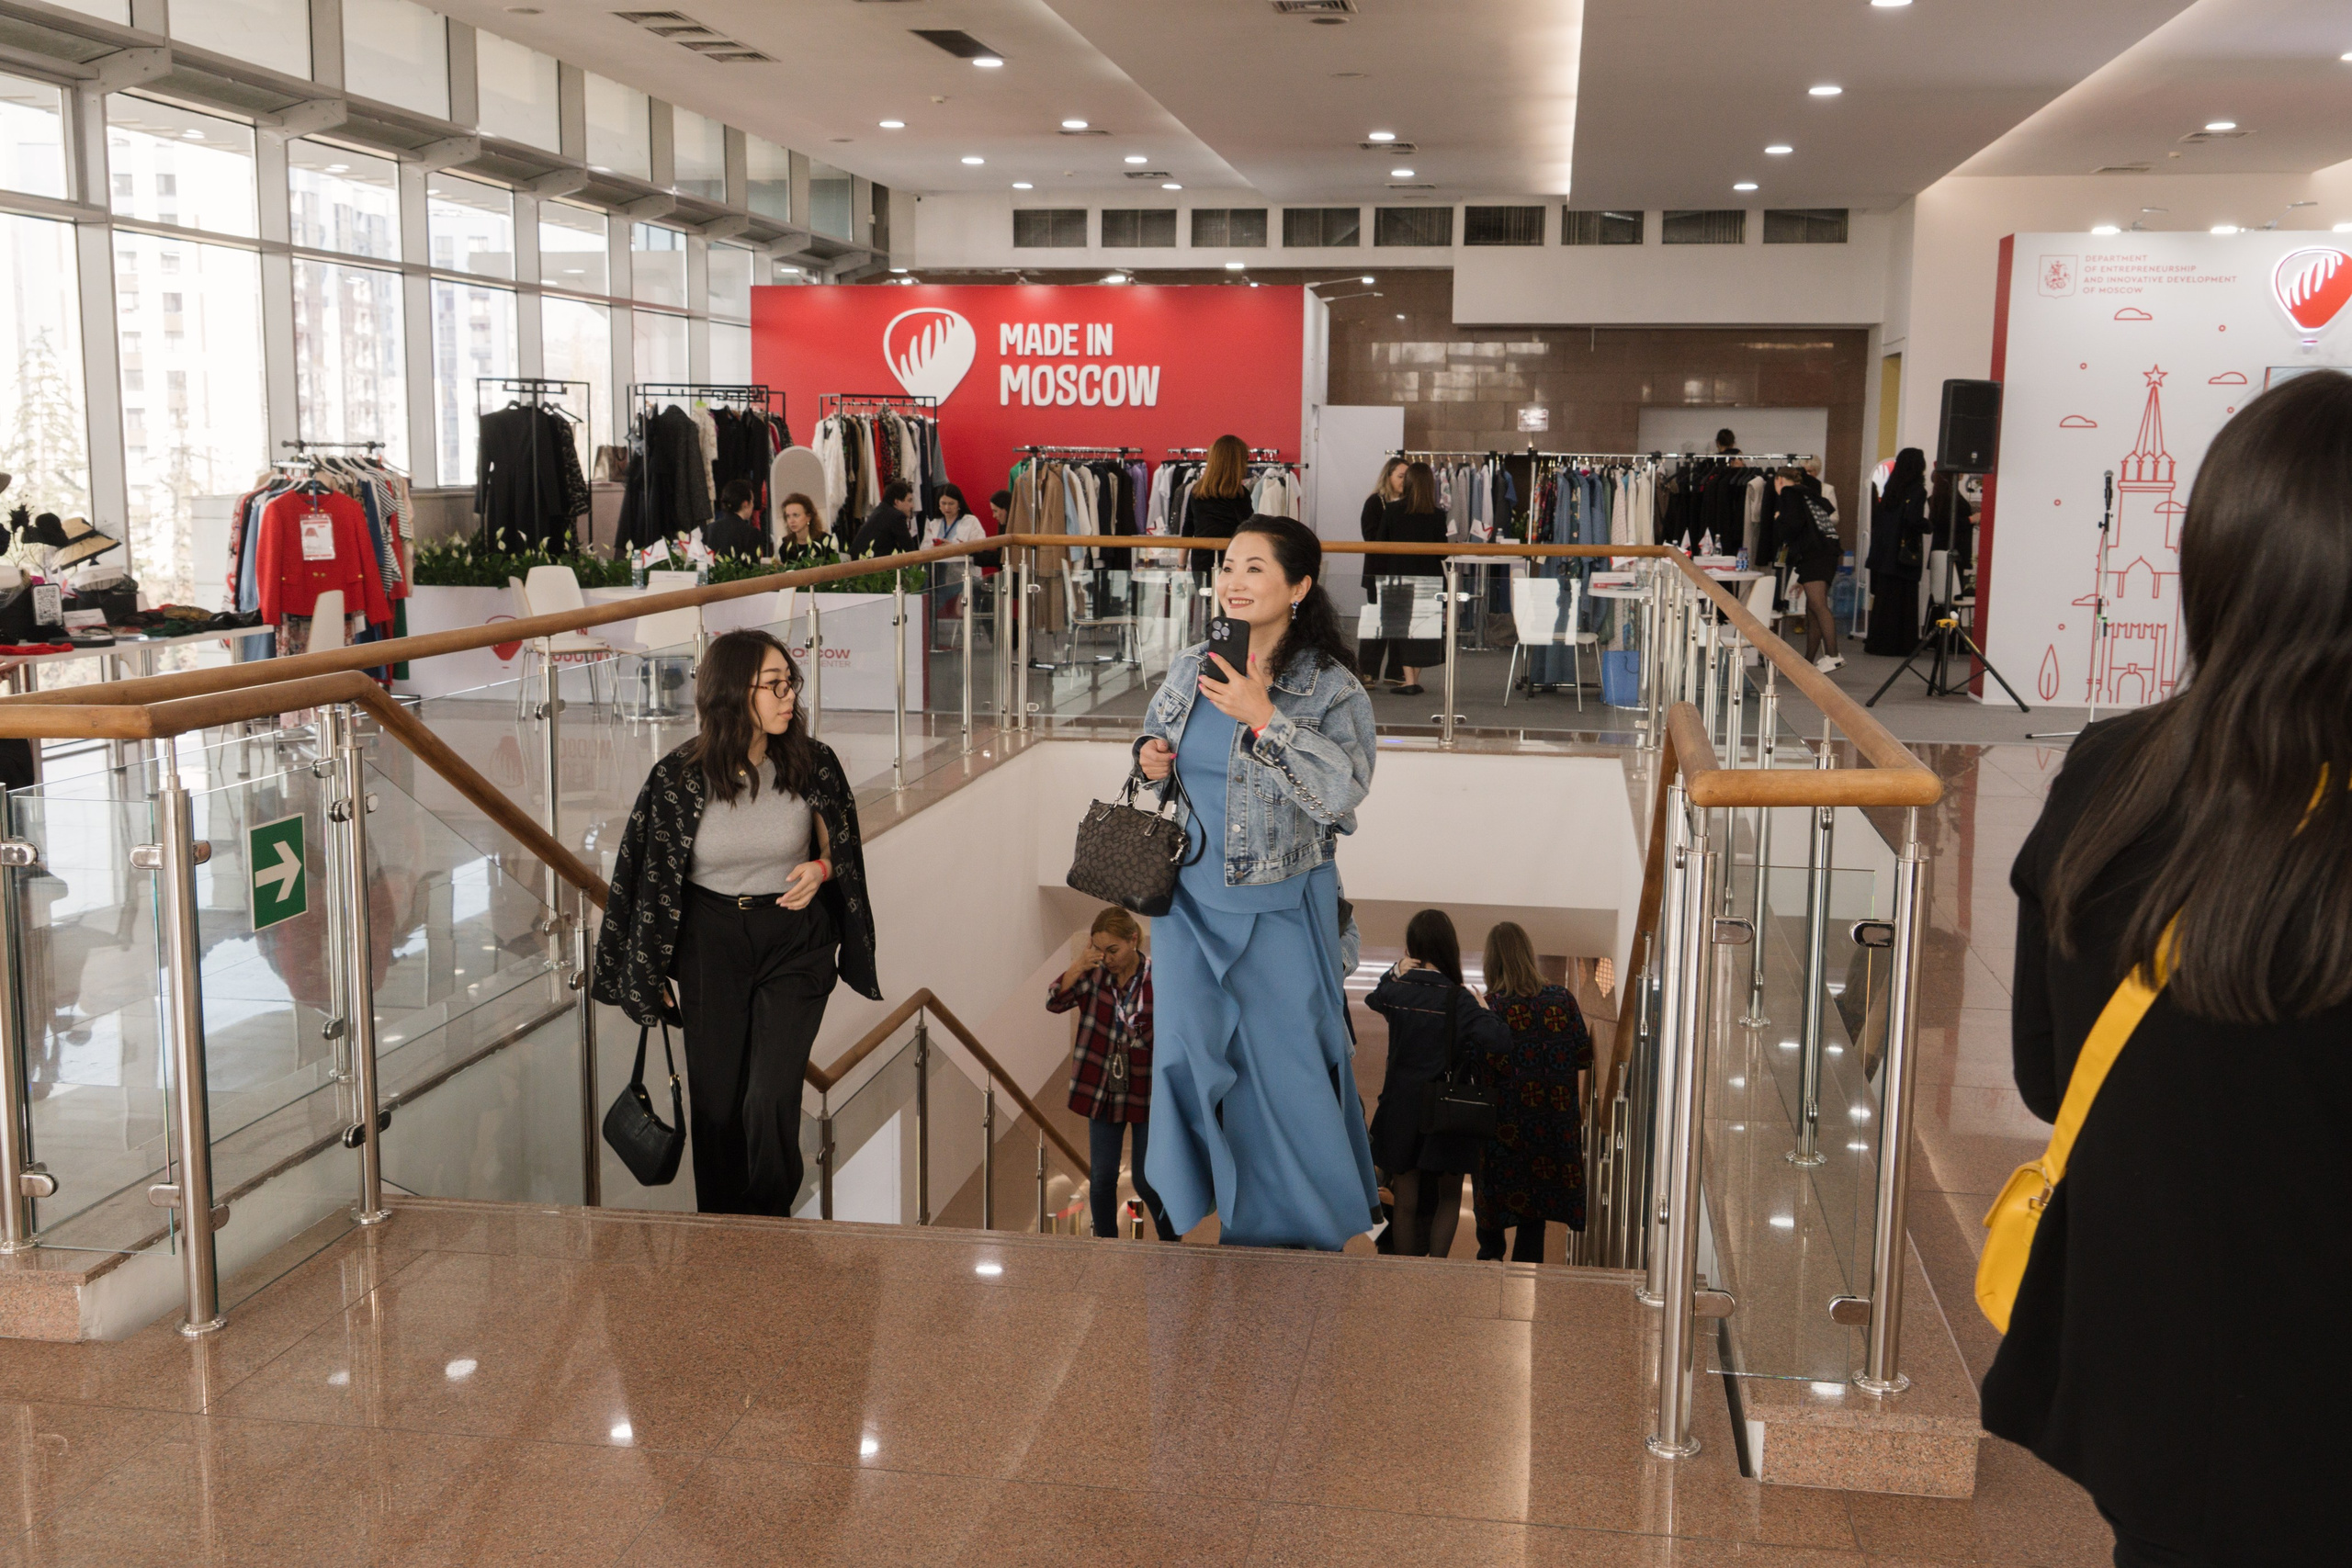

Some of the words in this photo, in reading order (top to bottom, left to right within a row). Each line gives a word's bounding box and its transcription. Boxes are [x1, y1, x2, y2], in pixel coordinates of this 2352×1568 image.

[1000, 323, 1080, 355] MADE
[1086, 323, 1113, 355] IN
[1000, 364, 1160, 406] MOSCOW
